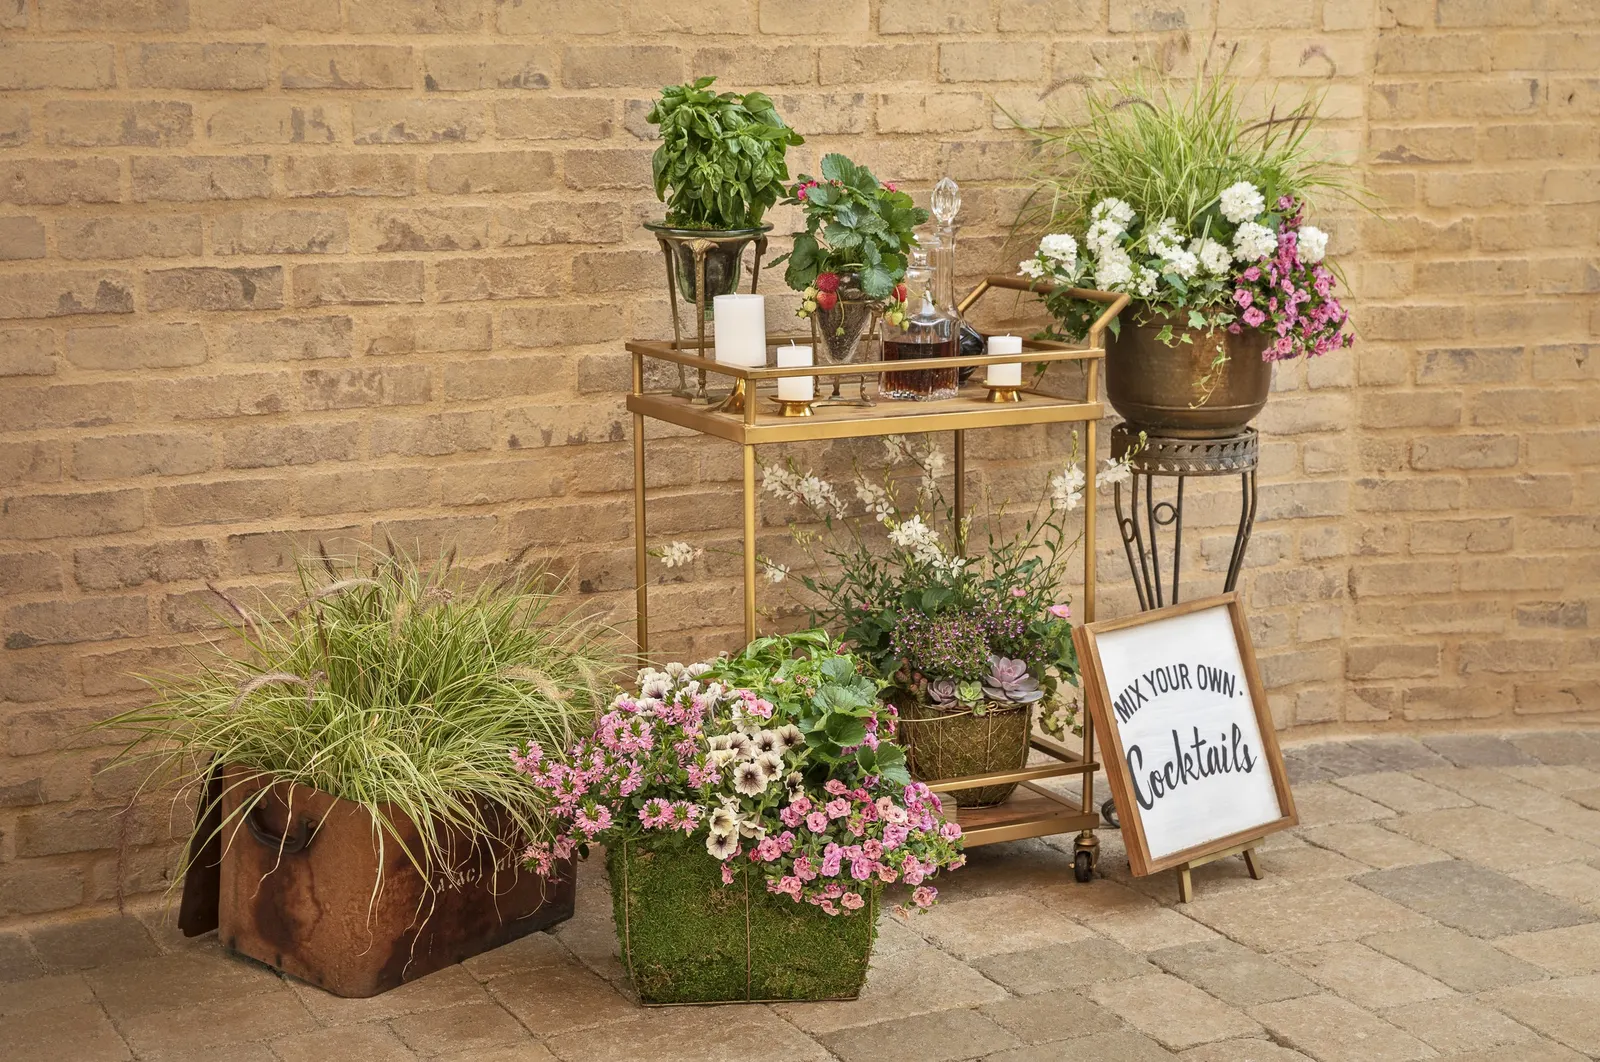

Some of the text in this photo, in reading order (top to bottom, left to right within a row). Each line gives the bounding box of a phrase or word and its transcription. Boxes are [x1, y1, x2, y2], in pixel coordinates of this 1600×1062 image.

[1113, 678, 1149, 724] MIX
[1142, 663, 1193, 697] YOUR
[1126, 722, 1258, 811] Cocktails
